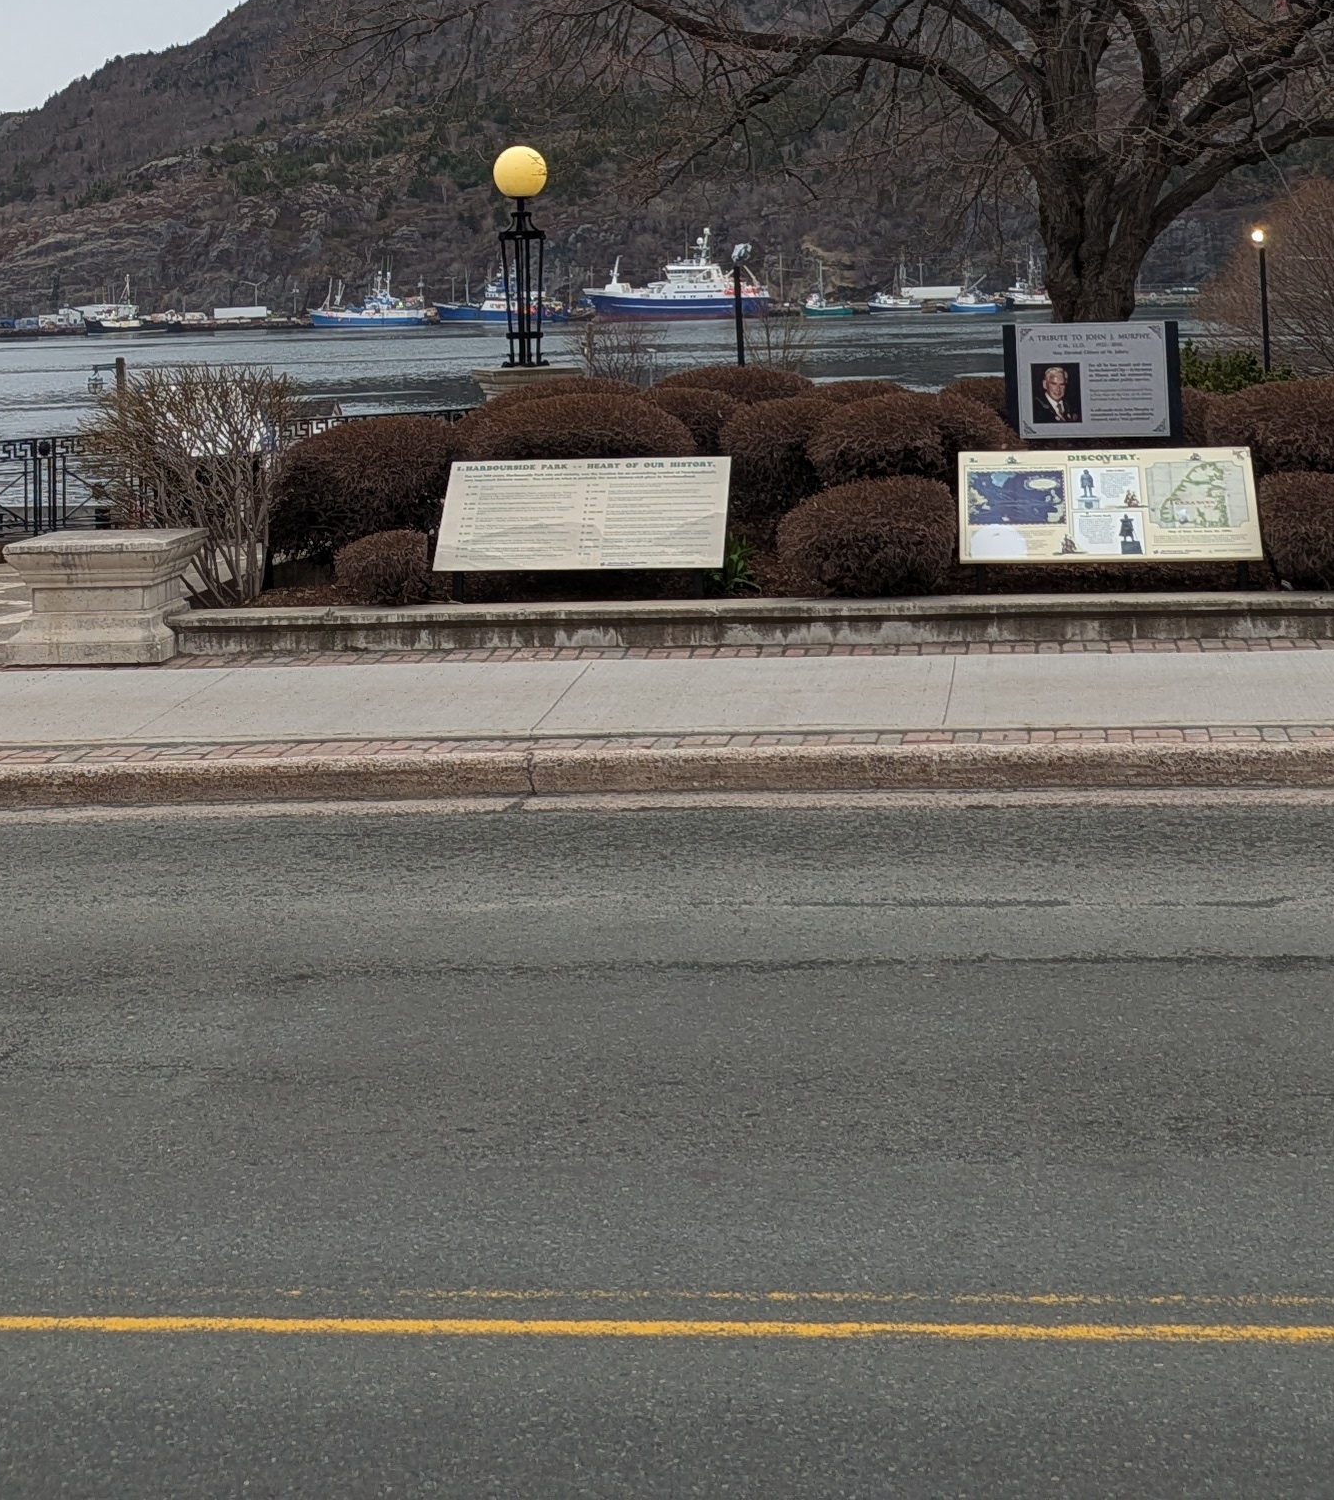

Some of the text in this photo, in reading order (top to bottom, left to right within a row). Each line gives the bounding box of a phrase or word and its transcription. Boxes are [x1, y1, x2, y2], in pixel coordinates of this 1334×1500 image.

[1037, 334, 1068, 342] TRIBUTE
[1071, 333, 1083, 341] TO
[1085, 333, 1107, 342] JOHN
[1067, 453, 1141, 464] DISCOVERY.
[466, 464, 536, 472] HARBOURSIDE
